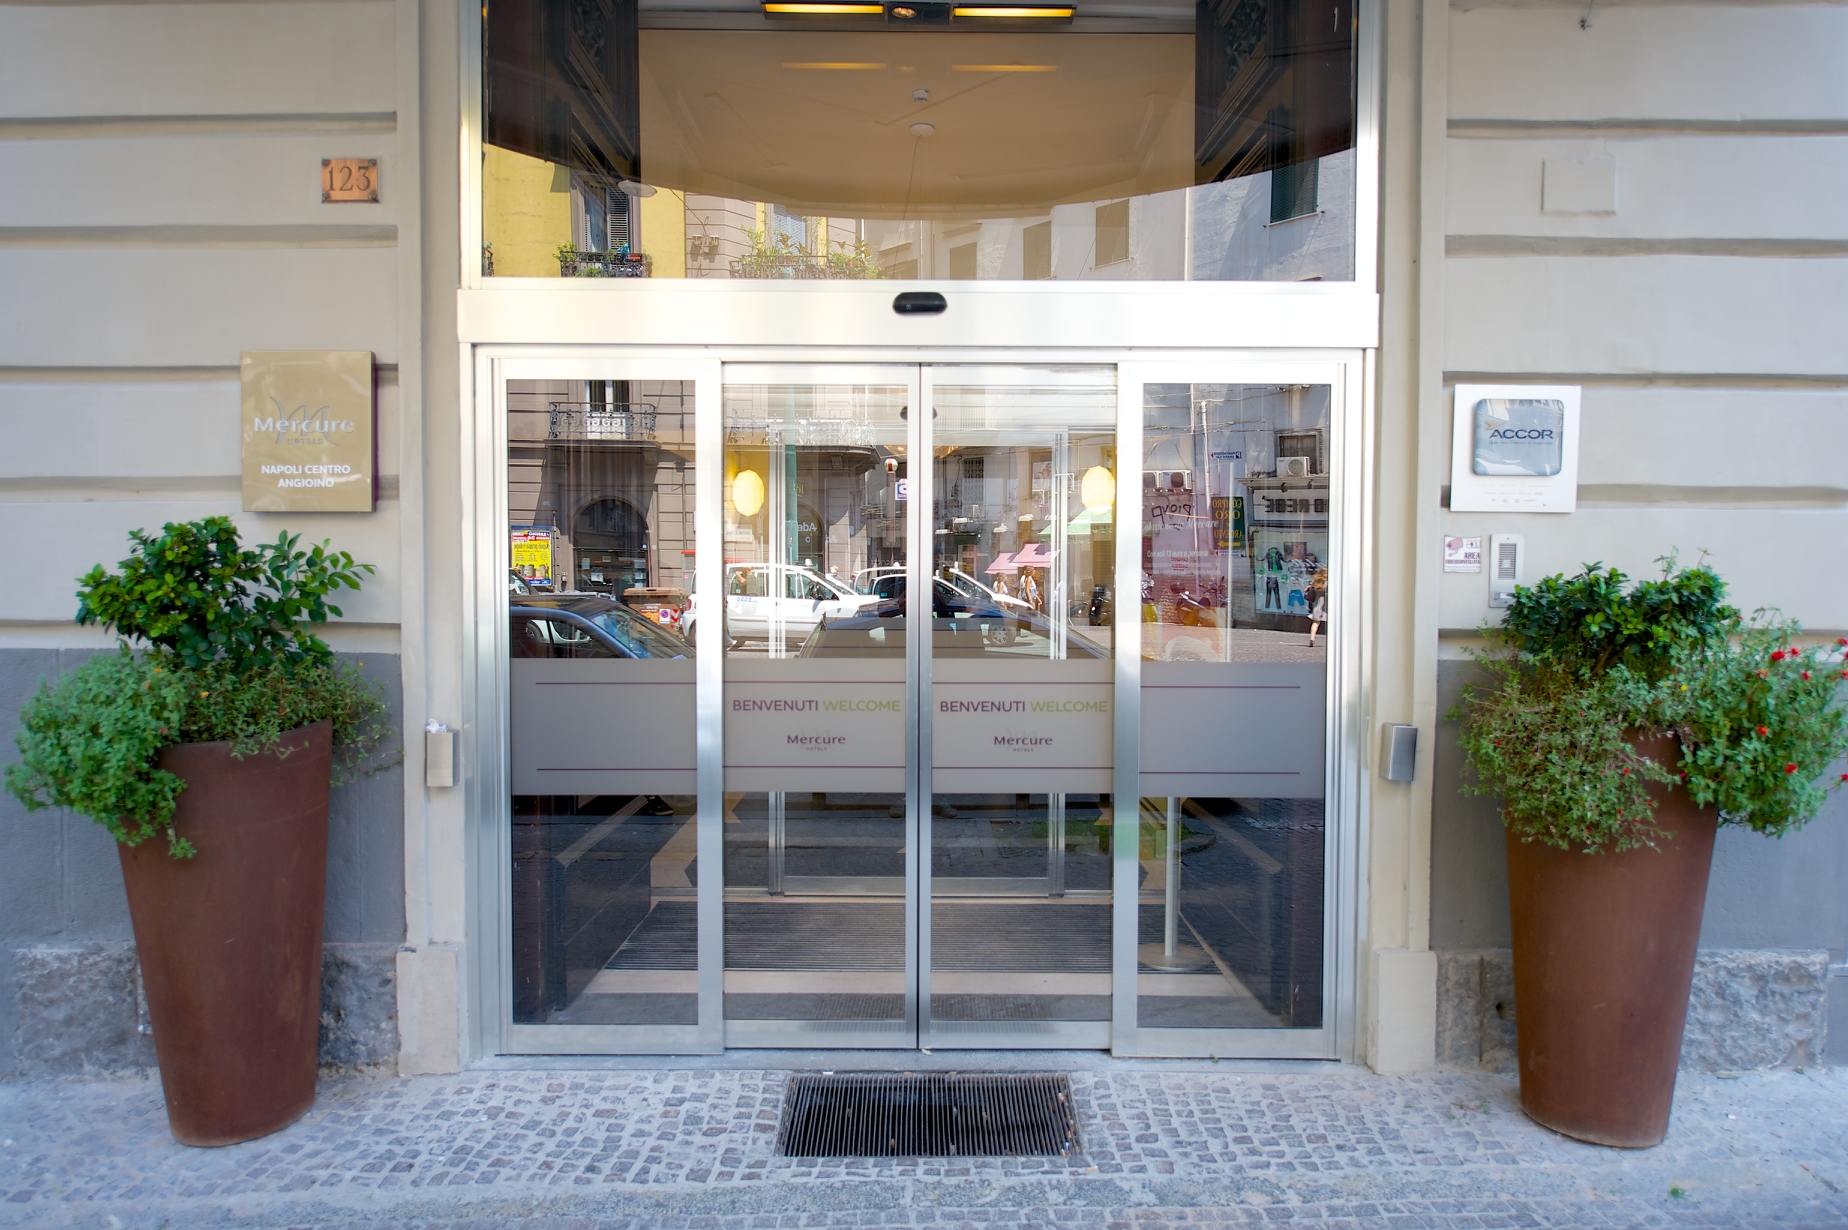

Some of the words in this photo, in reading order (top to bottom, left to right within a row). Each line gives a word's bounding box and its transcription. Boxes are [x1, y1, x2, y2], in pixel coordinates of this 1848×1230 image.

[328, 166, 371, 191] 123
[254, 417, 355, 433] Mercure
[1489, 429, 1554, 440] ACCOR
[261, 465, 303, 474] NAPOLI
[304, 465, 351, 474] CENTRO
[278, 478, 335, 488] ANGIOINO
[1144, 521, 1173, 531] olazione
[732, 699, 819, 712] BENVENUTI
[823, 699, 901, 712] WELCOME
[940, 700, 1026, 713] BENVENUTI
[1029, 700, 1108, 713] WELCOME
[786, 734, 846, 745] Mercure
[993, 736, 1053, 746] Mercure
